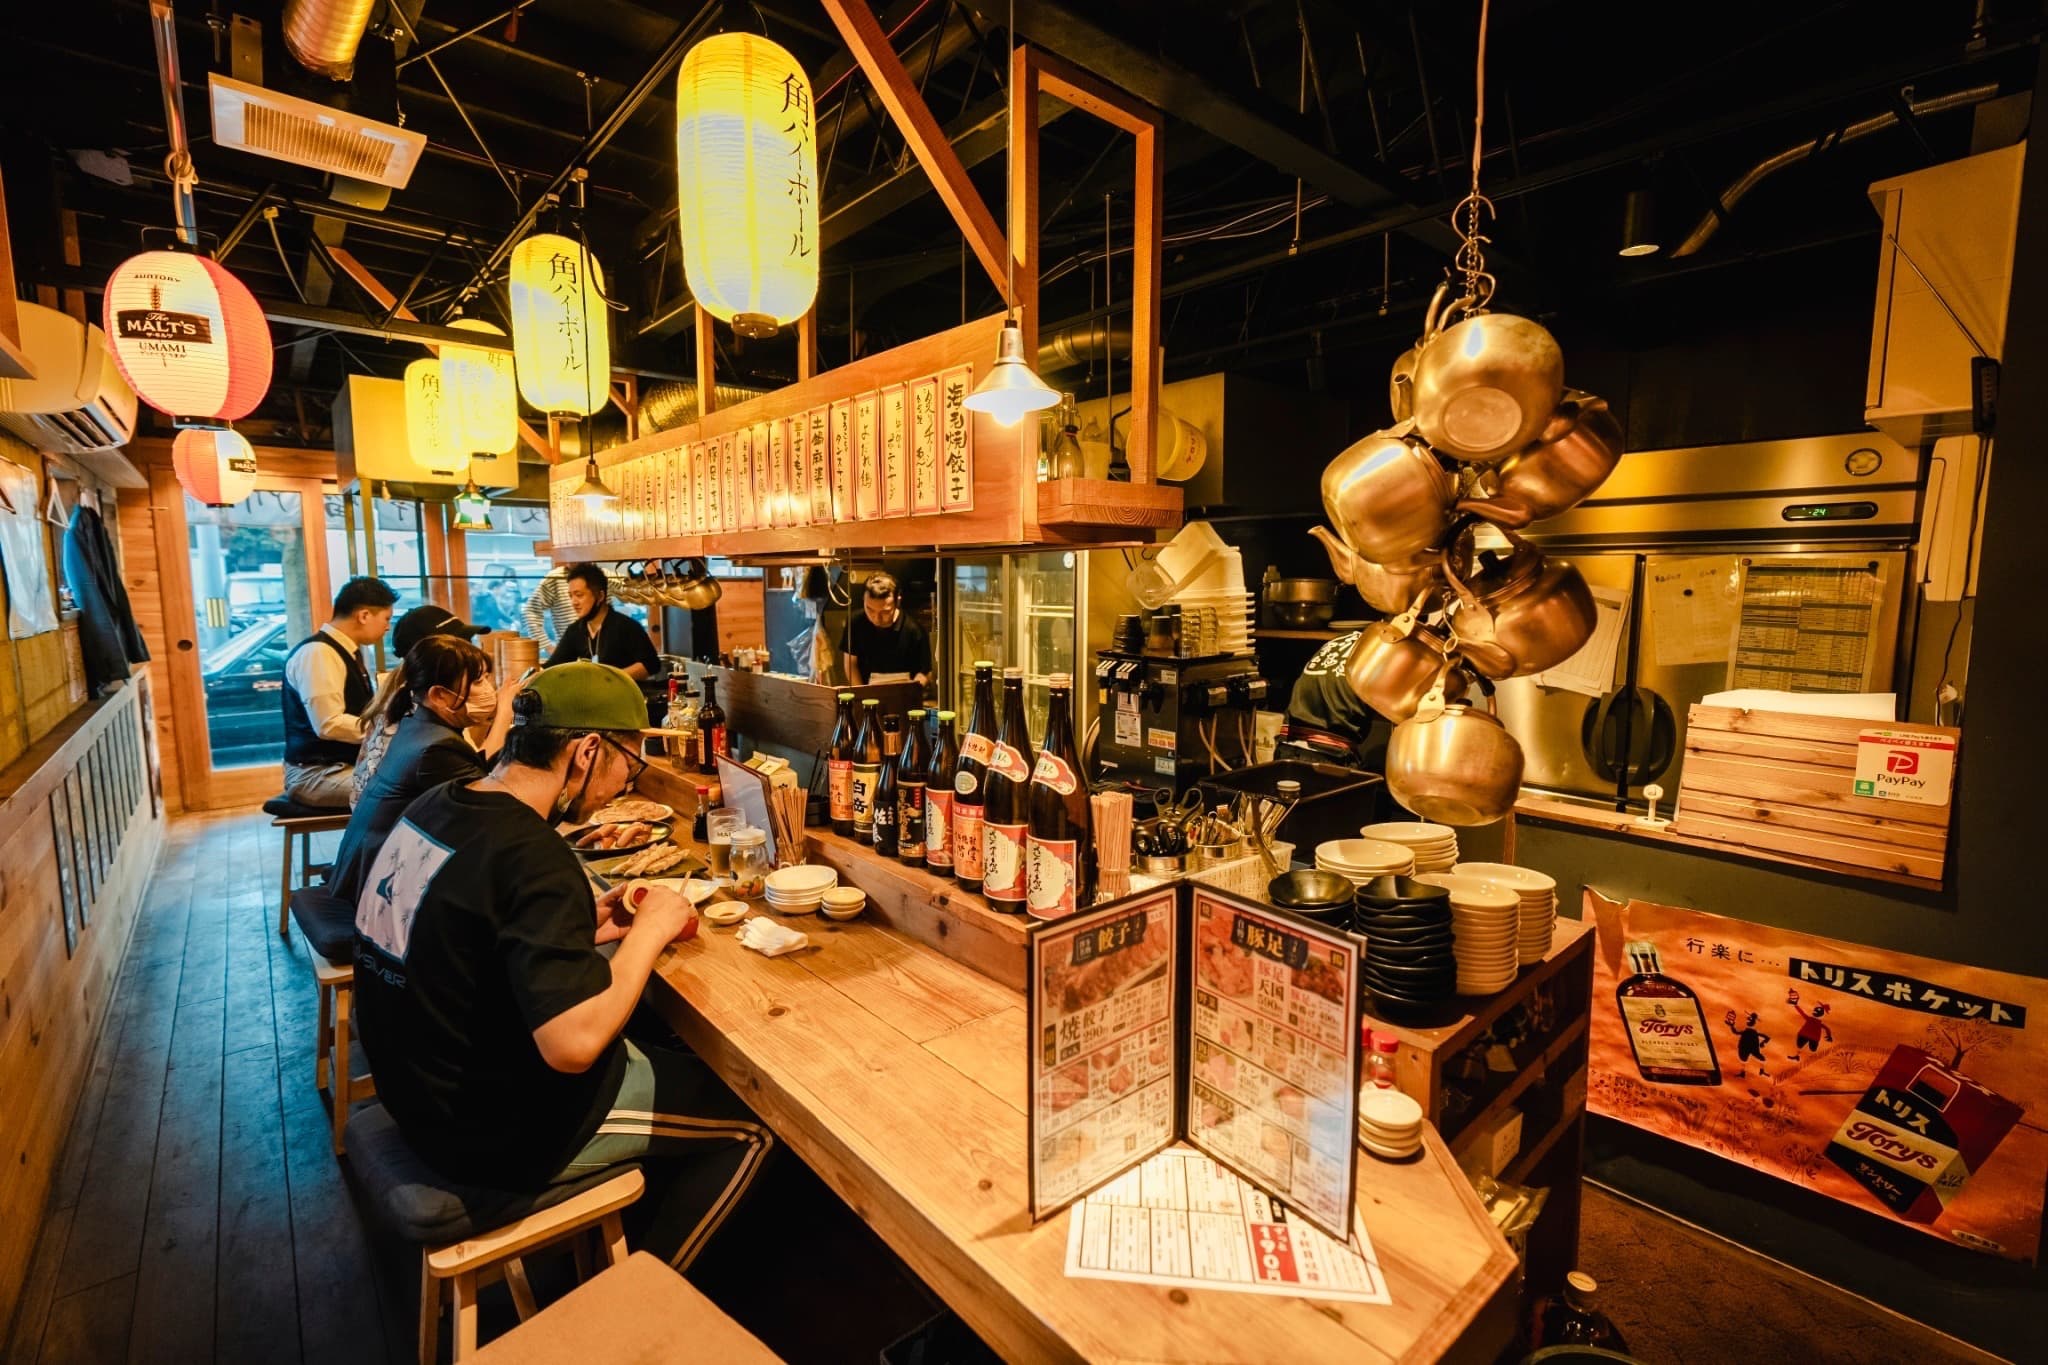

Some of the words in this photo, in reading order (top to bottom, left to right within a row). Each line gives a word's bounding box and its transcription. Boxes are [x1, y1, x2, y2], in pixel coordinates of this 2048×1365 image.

[780, 72, 812, 258] 角ハイボール
[126, 319, 197, 336] MALT'S
[145, 312, 170, 322] The
[549, 252, 583, 371] 角ハイボール
[137, 341, 188, 354] UMAMI
[1876, 772, 1927, 790] PayPay
[1098, 921, 1131, 953] 餃子
[1247, 923, 1284, 959] 豚足
[1257, 979, 1285, 1001] 天国
[1800, 961, 2013, 1023] トリスポケット
[1639, 1018, 1694, 1037] Torys
[1874, 1088, 1931, 1135] トリス
[1846, 1120, 1939, 1170] Torys
[1855, 1161, 1904, 1197] サントリー
